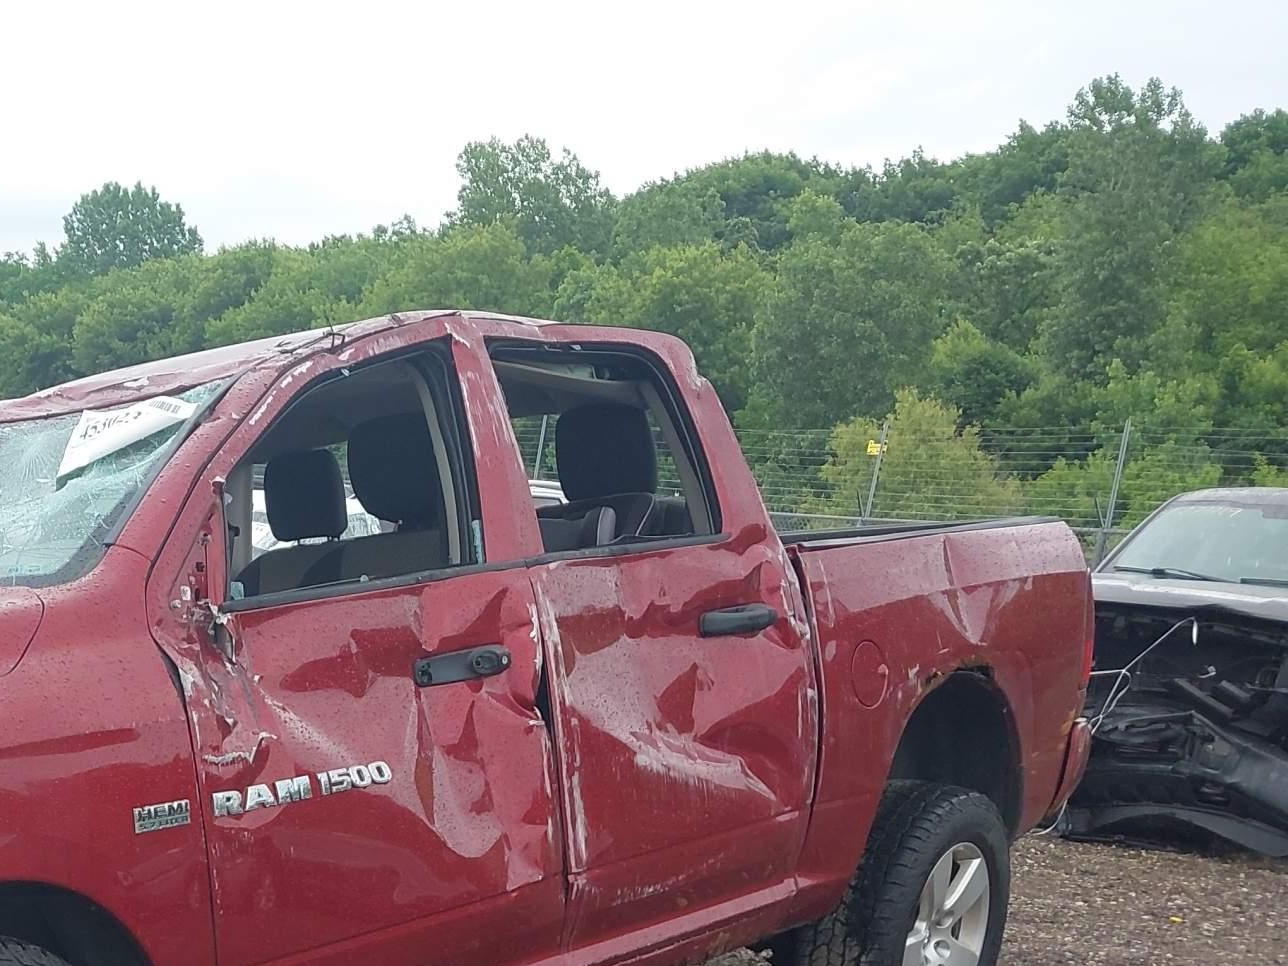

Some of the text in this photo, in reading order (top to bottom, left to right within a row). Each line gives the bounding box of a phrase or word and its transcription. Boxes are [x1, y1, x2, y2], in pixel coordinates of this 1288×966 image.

[212, 760, 392, 817] RAM 1500
[136, 801, 189, 823] HEMI
